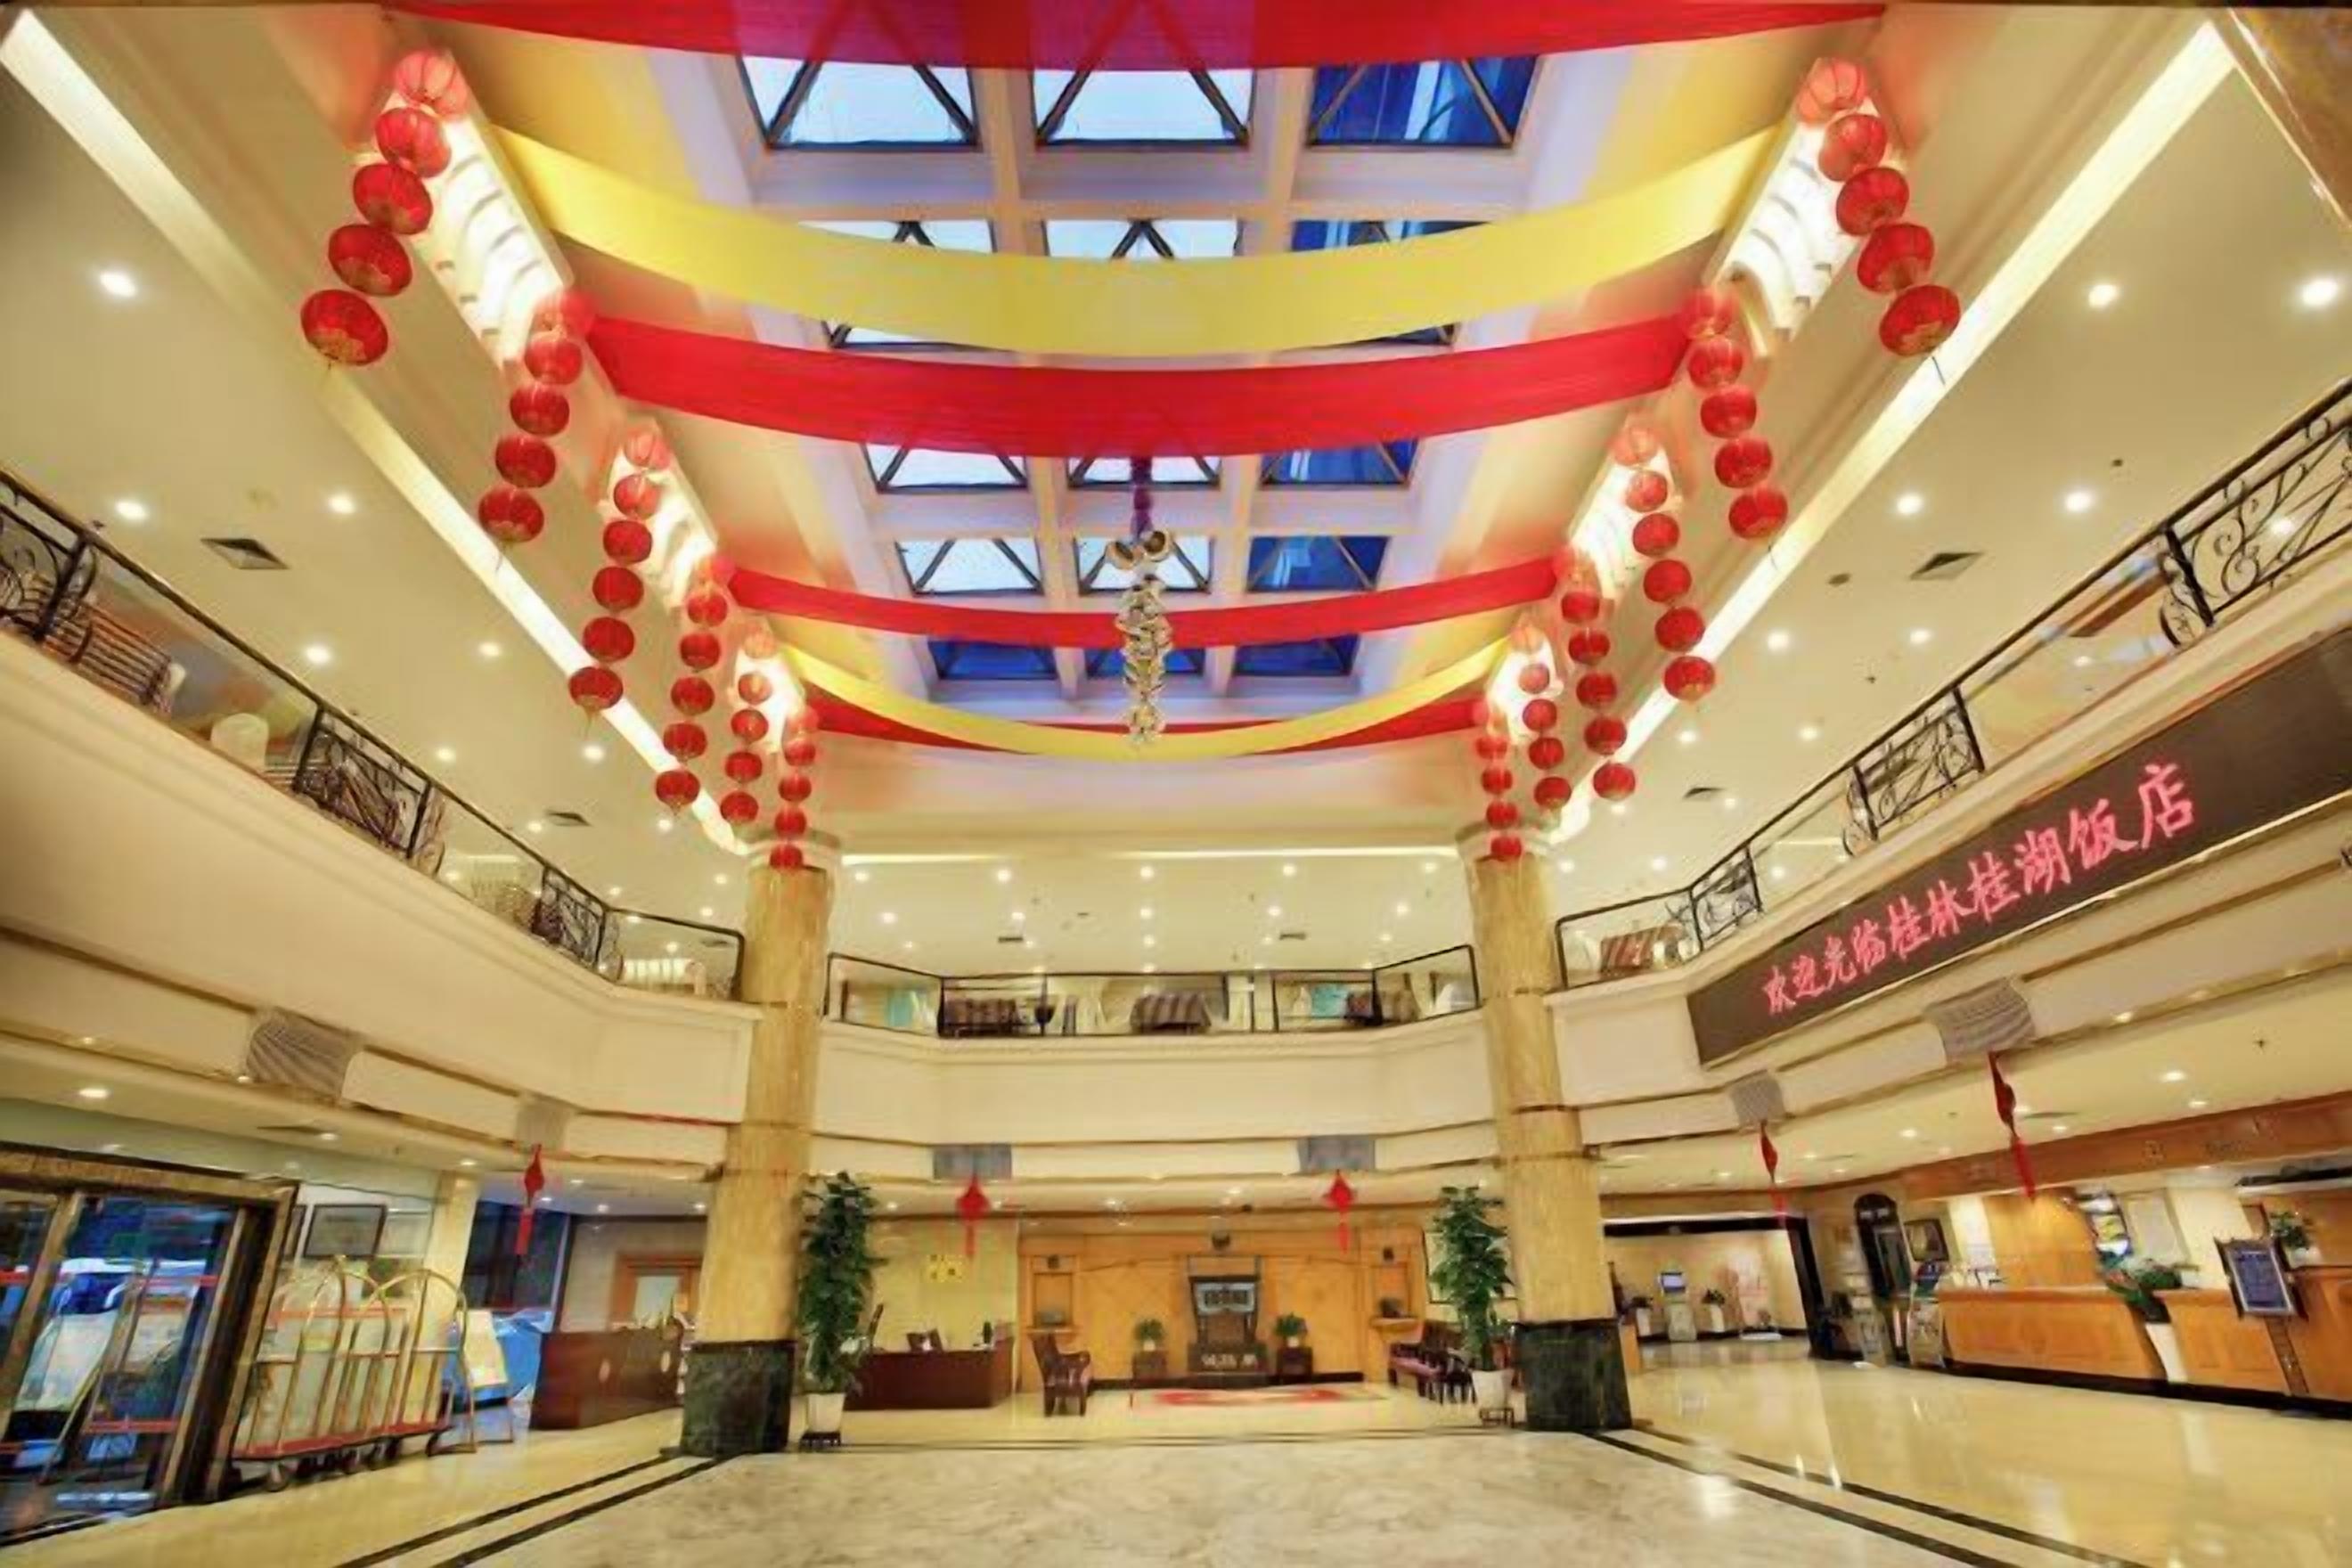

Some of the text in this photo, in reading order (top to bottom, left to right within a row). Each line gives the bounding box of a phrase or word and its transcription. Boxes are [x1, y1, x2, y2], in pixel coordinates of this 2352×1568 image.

[1762, 763, 2195, 1015] 欢迎光临桂林桂湖饭店
